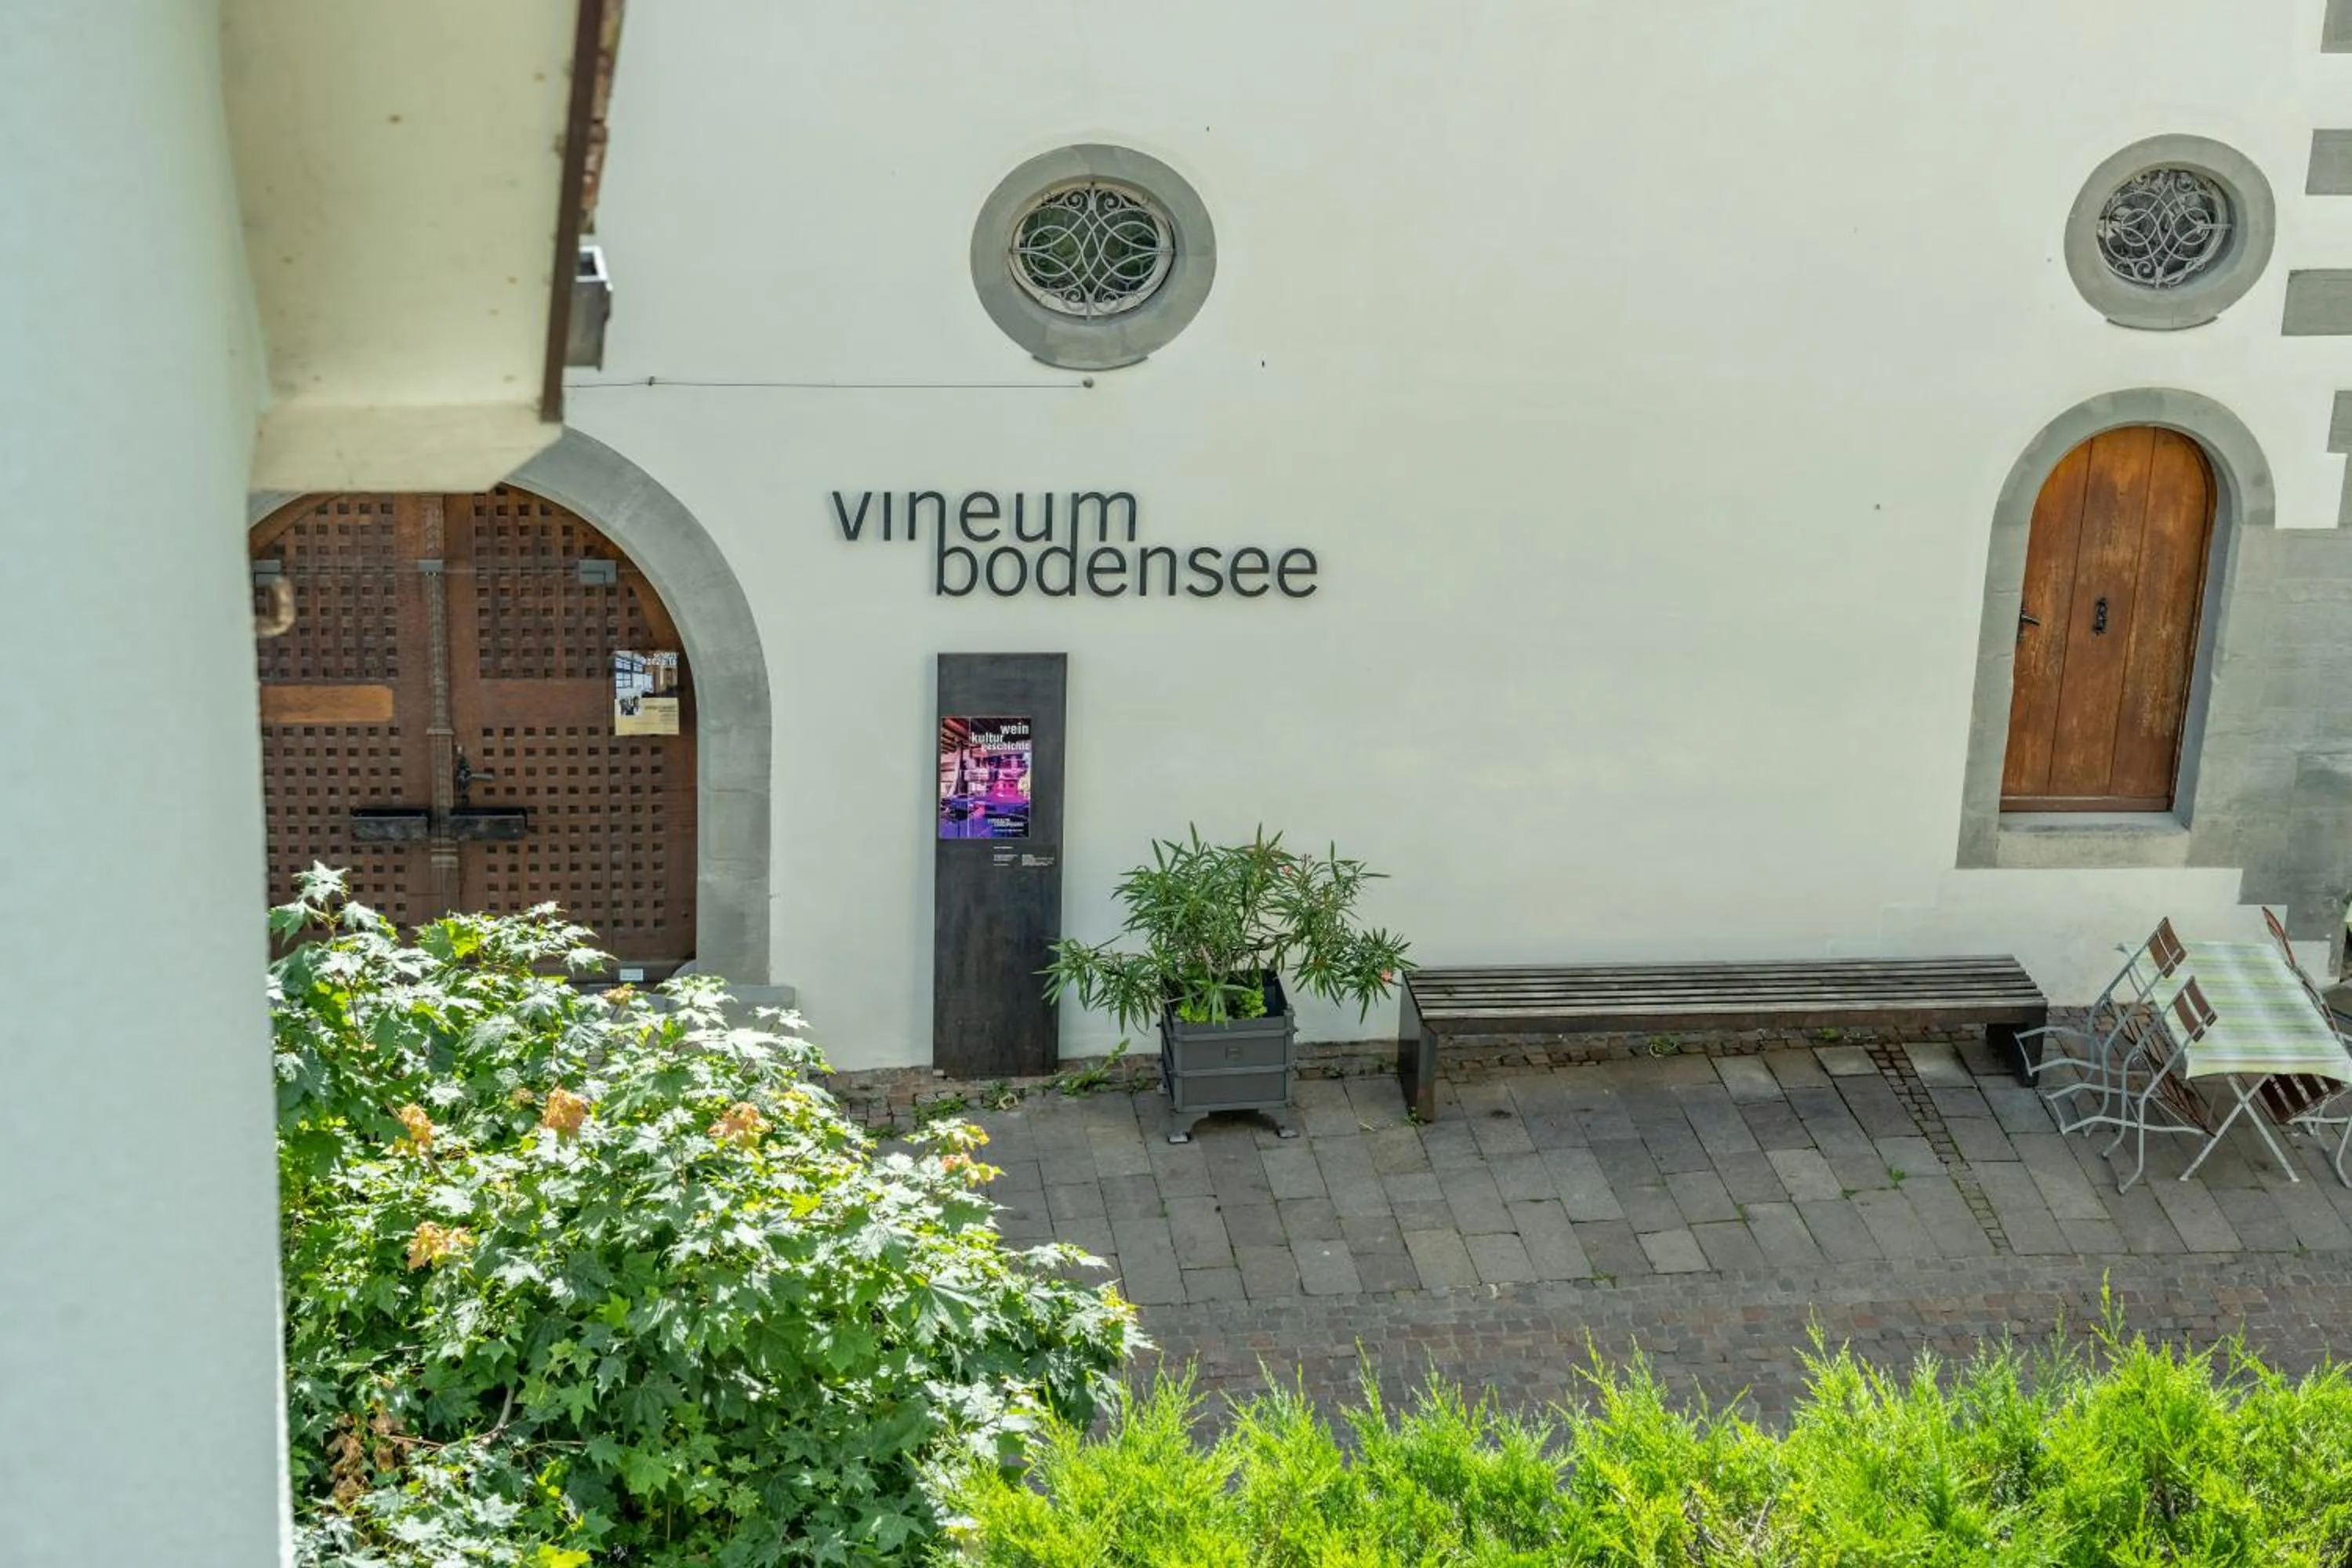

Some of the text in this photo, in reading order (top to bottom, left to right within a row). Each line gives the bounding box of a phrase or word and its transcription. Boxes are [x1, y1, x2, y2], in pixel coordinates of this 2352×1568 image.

[832, 491, 1138, 542] vineum
[936, 521, 1319, 597] bodensee
[971, 731, 1004, 743] kultur
[1000, 722, 1029, 735] wein
